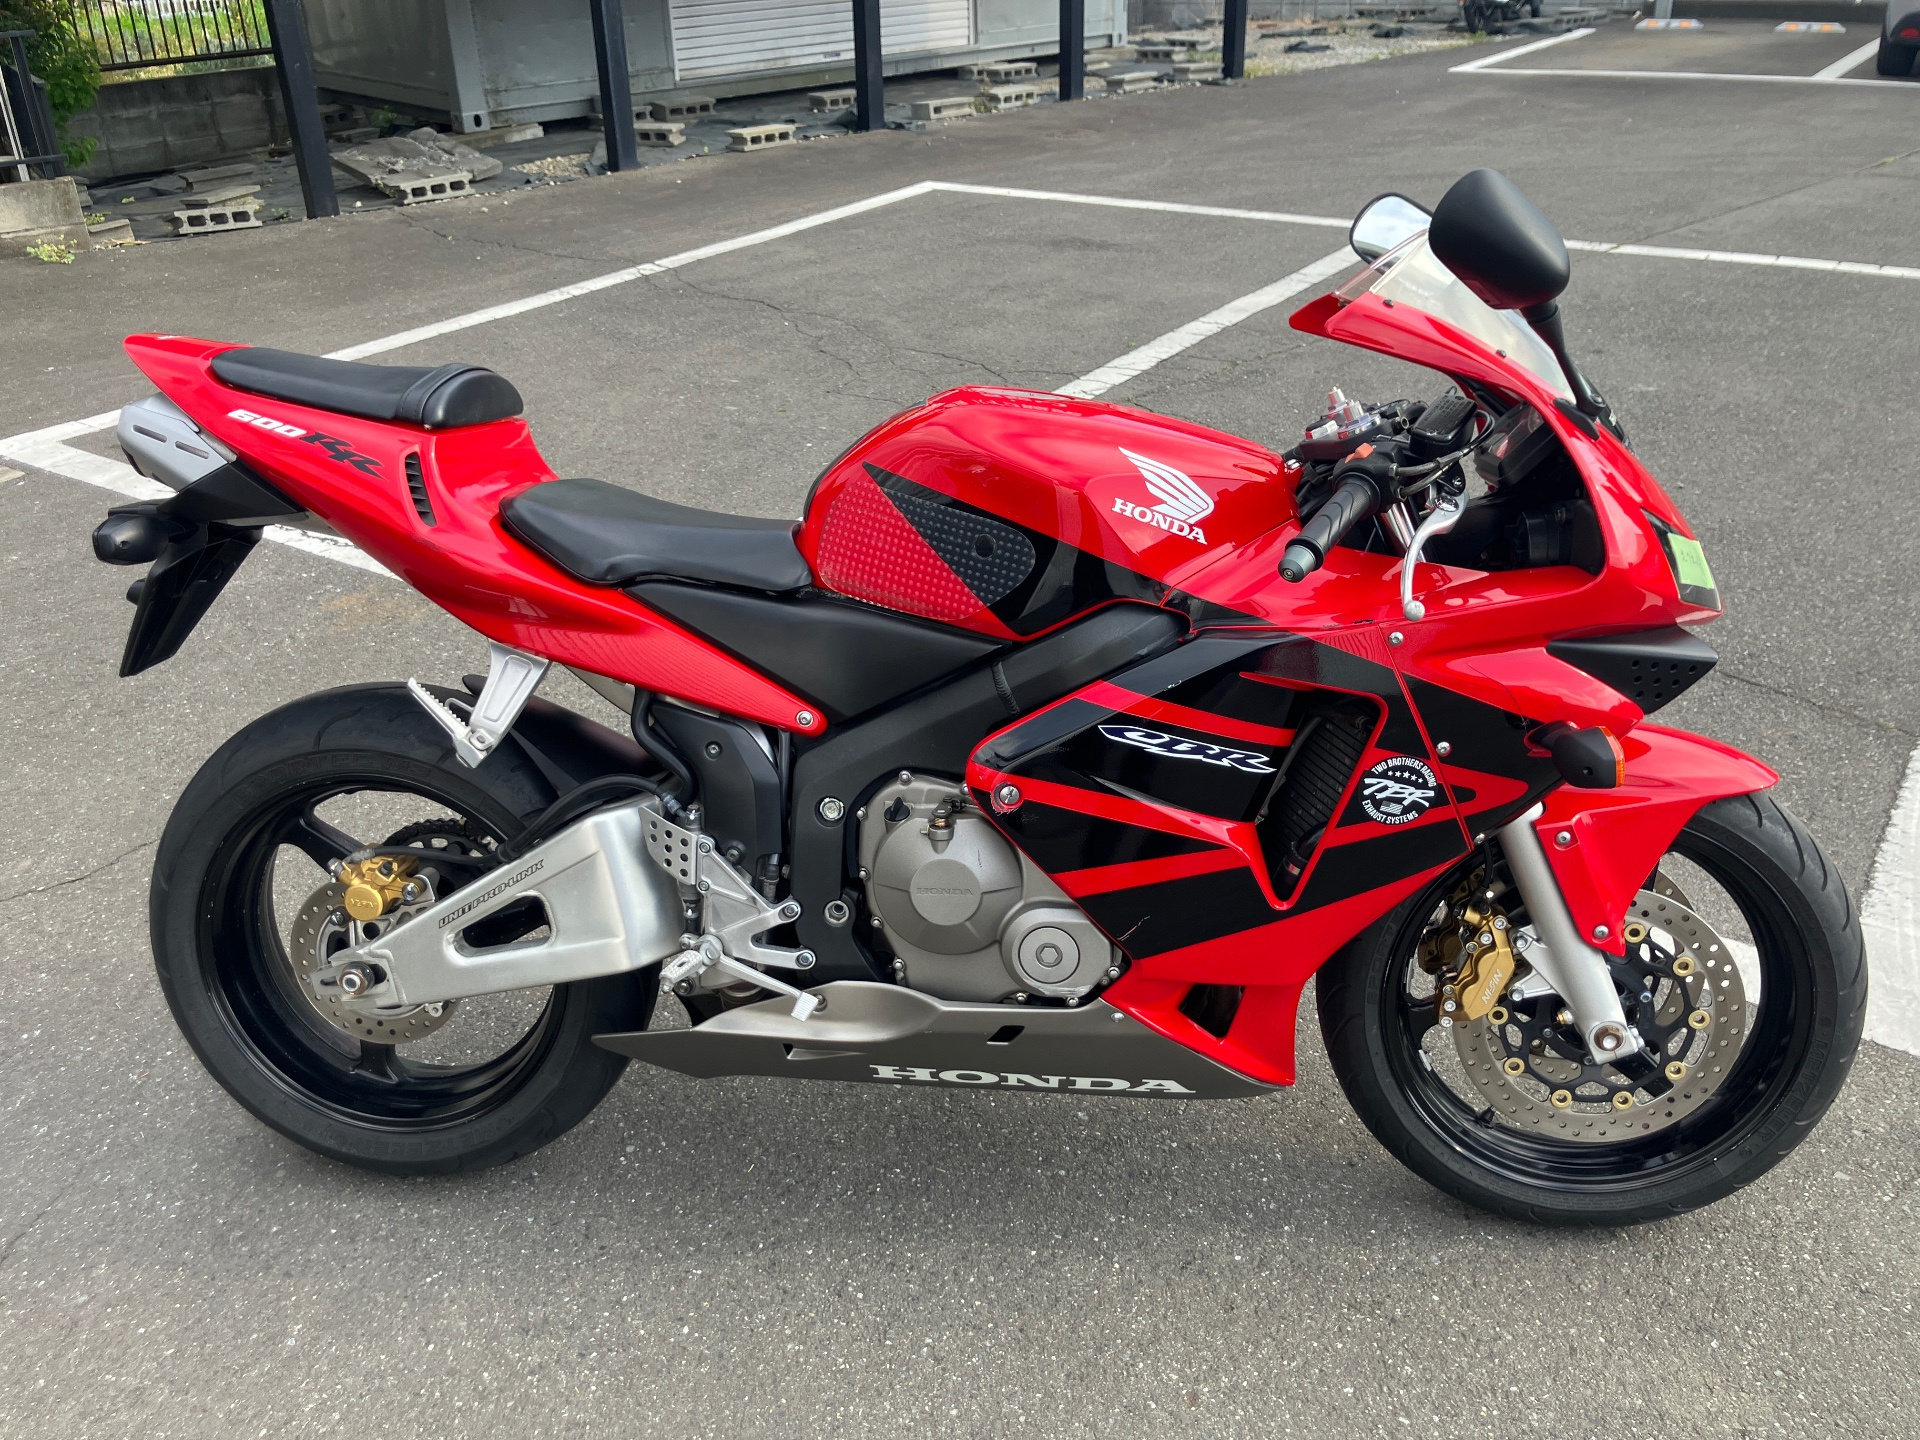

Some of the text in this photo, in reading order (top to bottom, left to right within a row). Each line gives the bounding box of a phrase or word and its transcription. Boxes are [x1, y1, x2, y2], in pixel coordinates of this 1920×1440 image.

[1111, 497, 1208, 545] HONDA
[1371, 757, 1437, 788] TWO BROTHERS RACING
[1361, 799, 1419, 825] EXHAUST SYSTEMS
[439, 858, 545, 929] UNIT PRO-LINK
[916, 887, 975, 897] HONDA
[1481, 968, 1503, 1005] NISSIN
[869, 1064, 1197, 1094] HONDA
